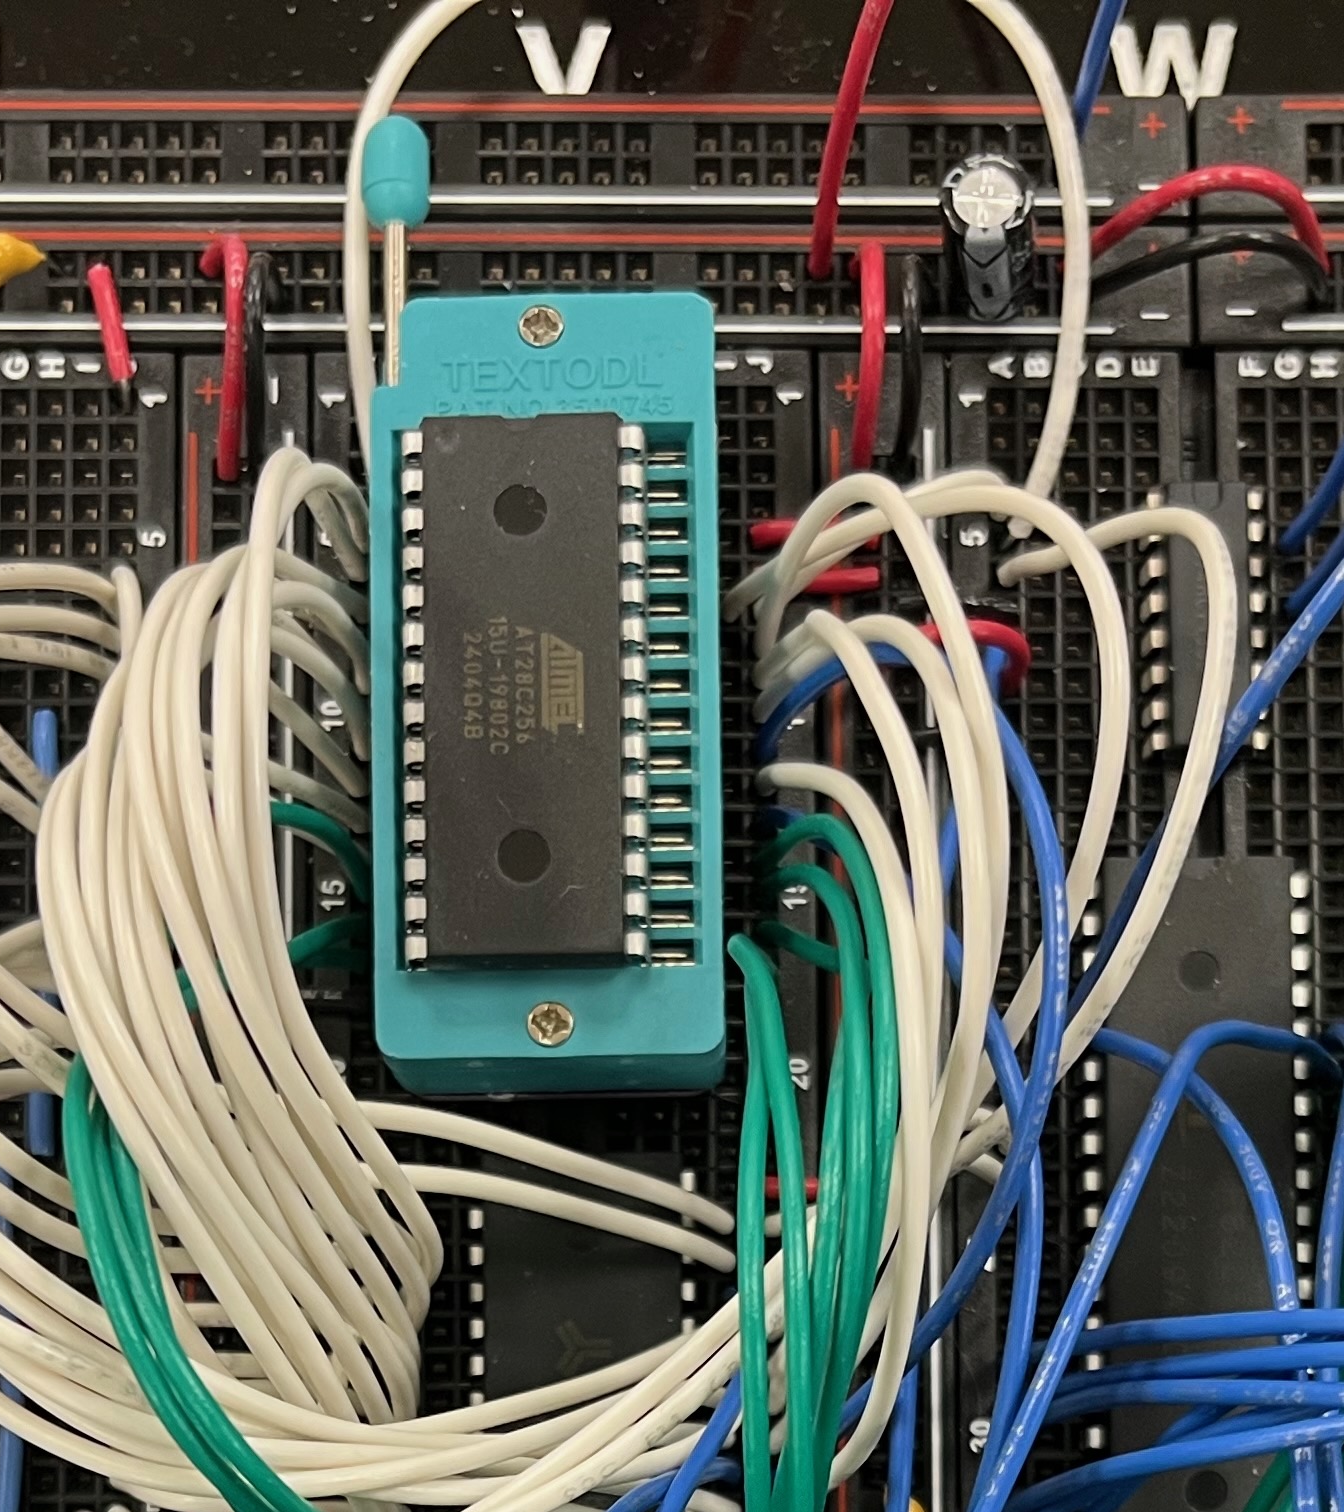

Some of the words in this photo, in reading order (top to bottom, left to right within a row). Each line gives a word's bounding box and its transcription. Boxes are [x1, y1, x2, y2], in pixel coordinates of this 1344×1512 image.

[515, 22, 611, 95] V
[1110, 22, 1237, 98] W
[140, 392, 168, 409] 1
[138, 527, 167, 549] 5
[959, 527, 987, 547] 5
[488, 616, 509, 756] 15U-19802C
[514, 625, 534, 745] AT28C256
[320, 700, 344, 732] 10
[320, 878, 346, 912] 15
[786, 1056, 812, 1092] 20
[969, 1418, 992, 1454] 30
